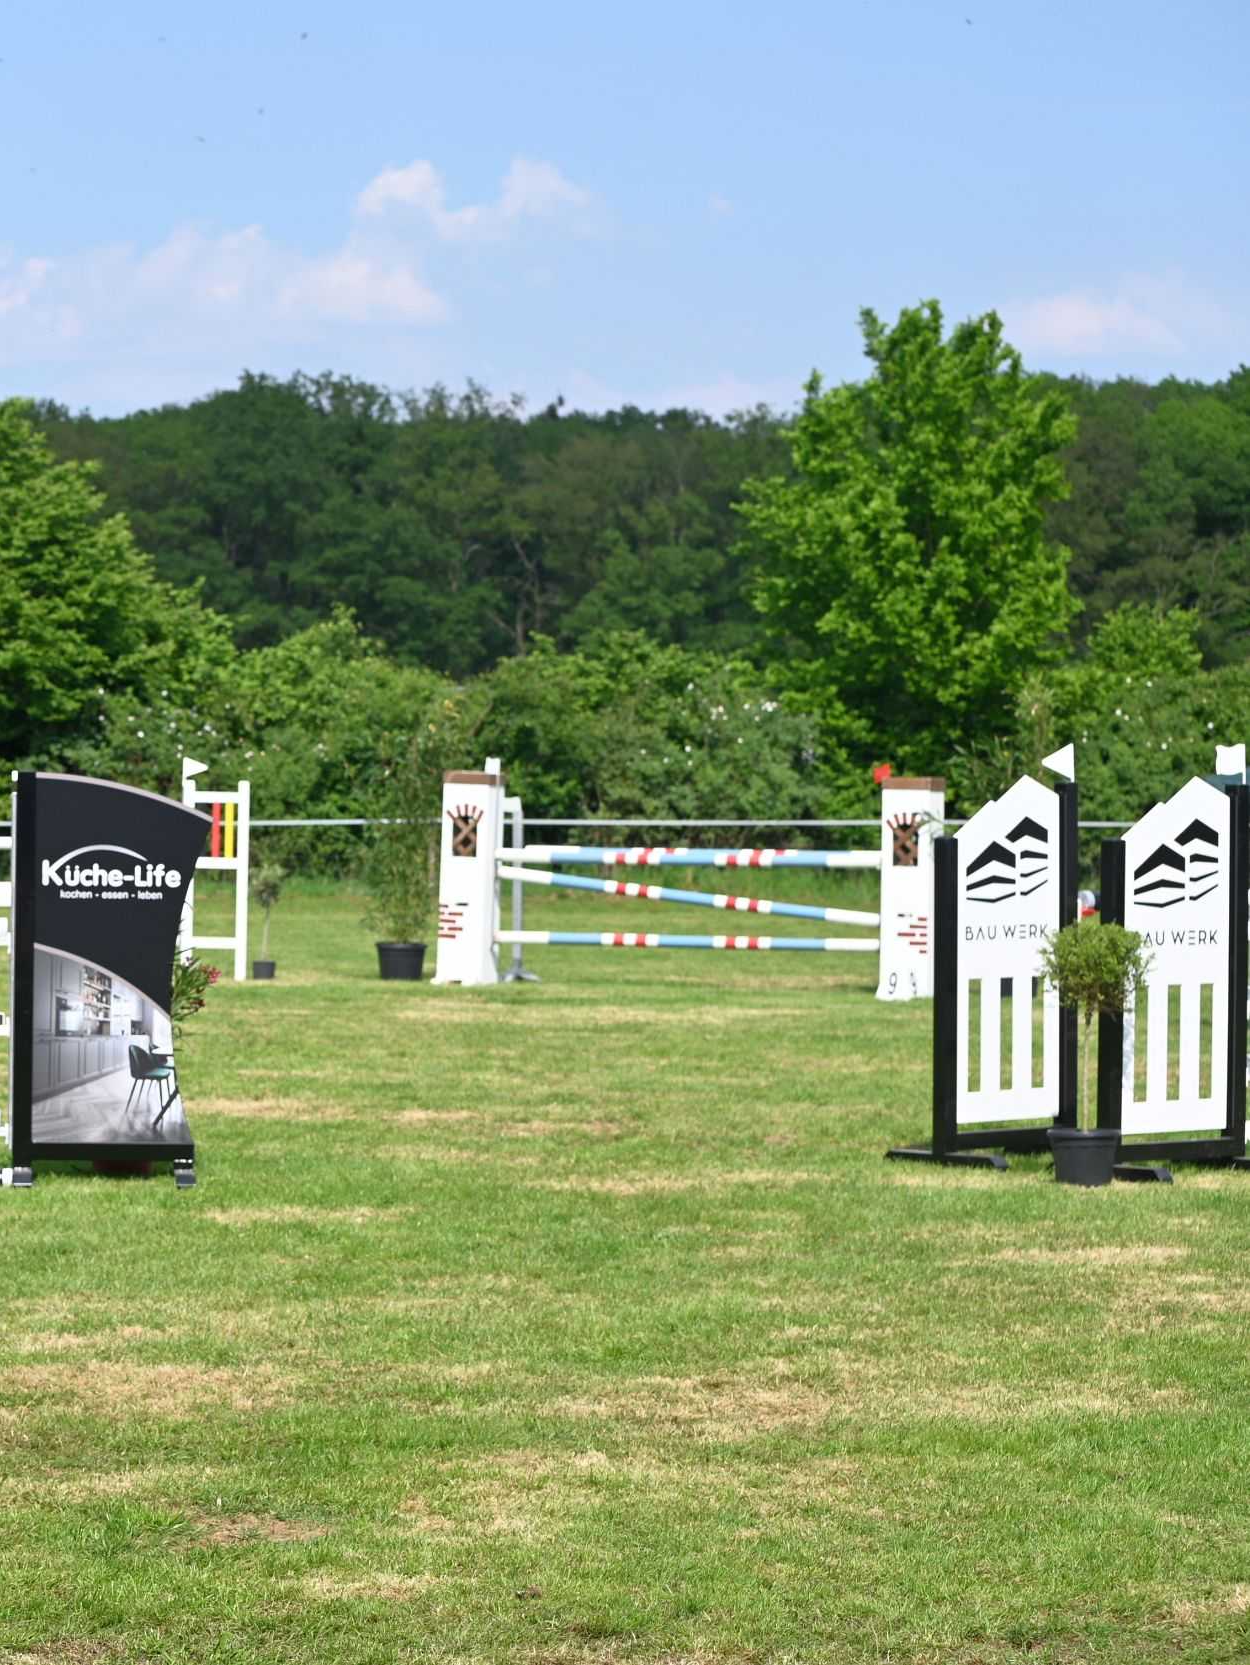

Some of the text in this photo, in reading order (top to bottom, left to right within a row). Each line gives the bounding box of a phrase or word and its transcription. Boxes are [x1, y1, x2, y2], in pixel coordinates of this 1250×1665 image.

[41, 859, 182, 888] Küche-Life
[60, 889, 163, 900] kochen essen leben
[965, 924, 1048, 941] BAU WERK
[1171, 929, 1218, 945] WERK
